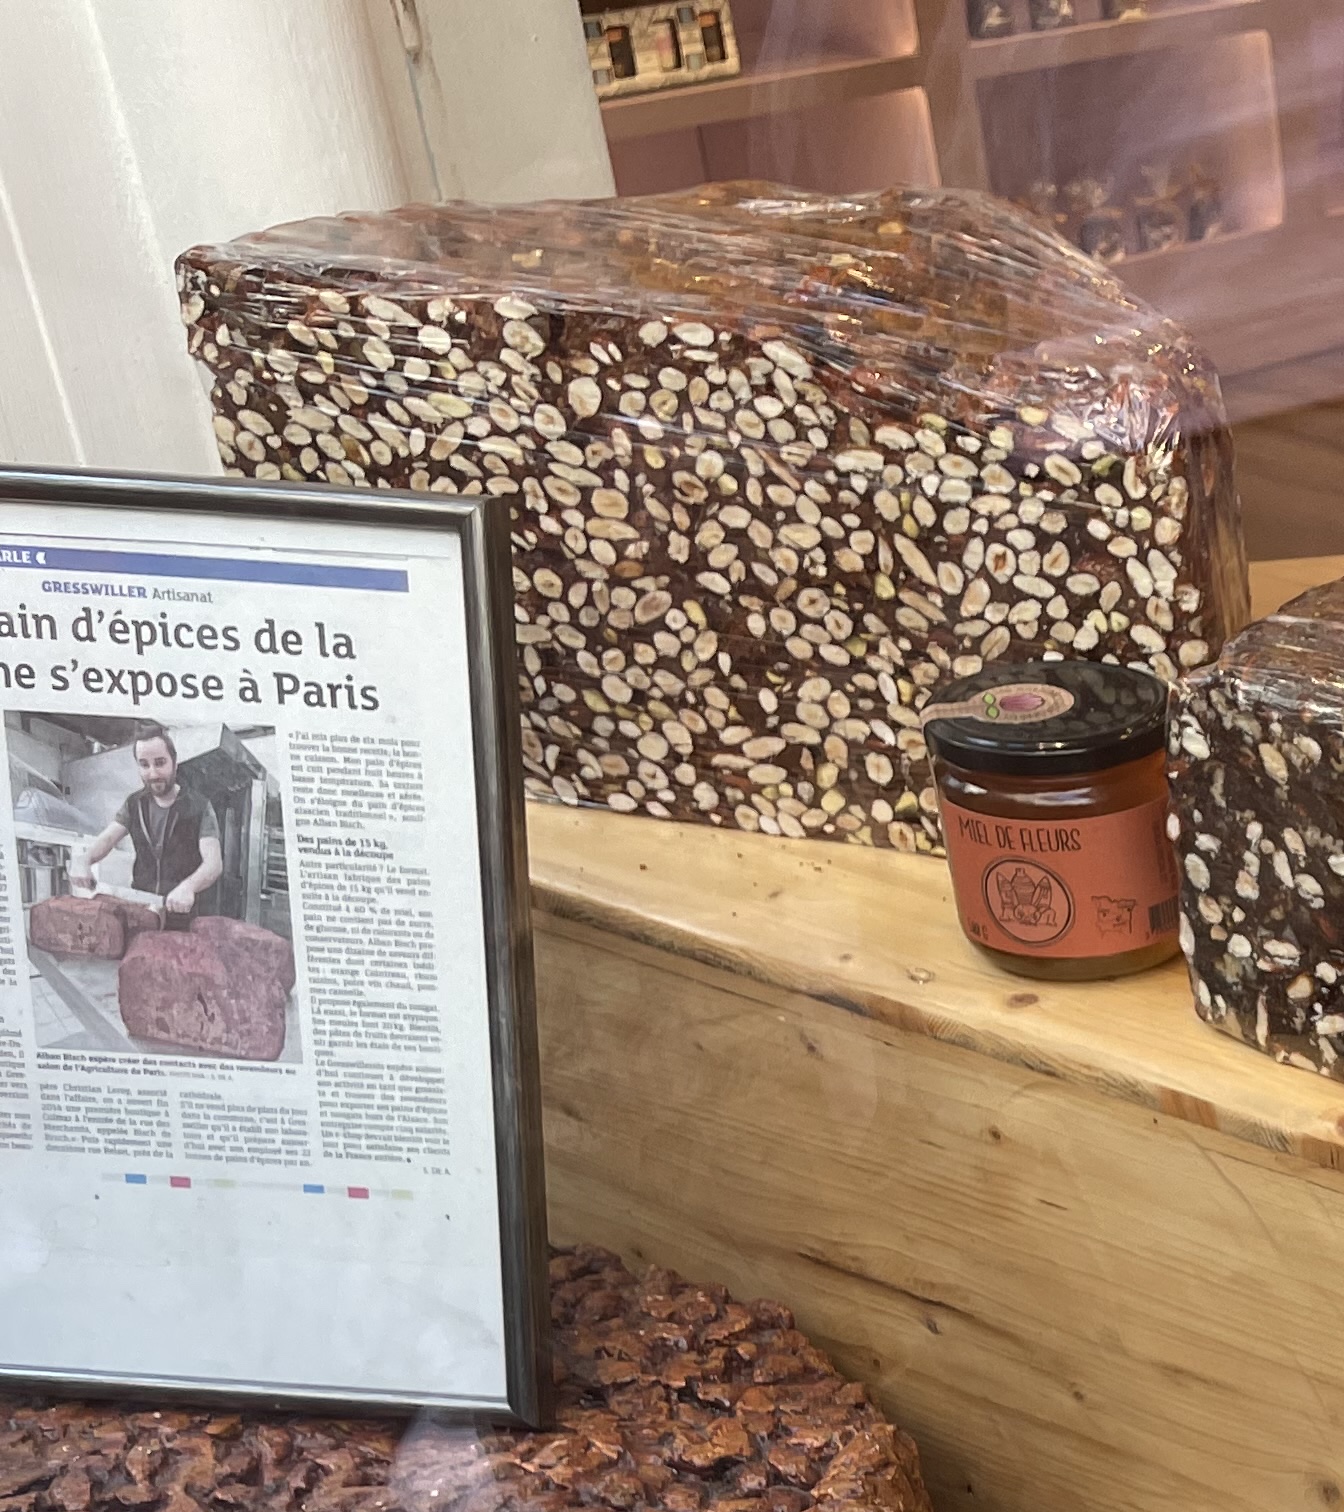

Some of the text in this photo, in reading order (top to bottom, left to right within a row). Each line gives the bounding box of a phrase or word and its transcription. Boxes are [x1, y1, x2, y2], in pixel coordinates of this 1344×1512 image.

[0, 549, 32, 563] RLE
[42, 580, 214, 604] GRESSWILLER Artisanat
[72, 606, 241, 656] d'épices
[254, 619, 303, 656] de
[314, 622, 357, 660] la
[50, 659, 225, 706] s'expose
[239, 669, 262, 704] à
[273, 672, 381, 712] Paris
[958, 815, 1082, 852] MIEL DE FLEURS
